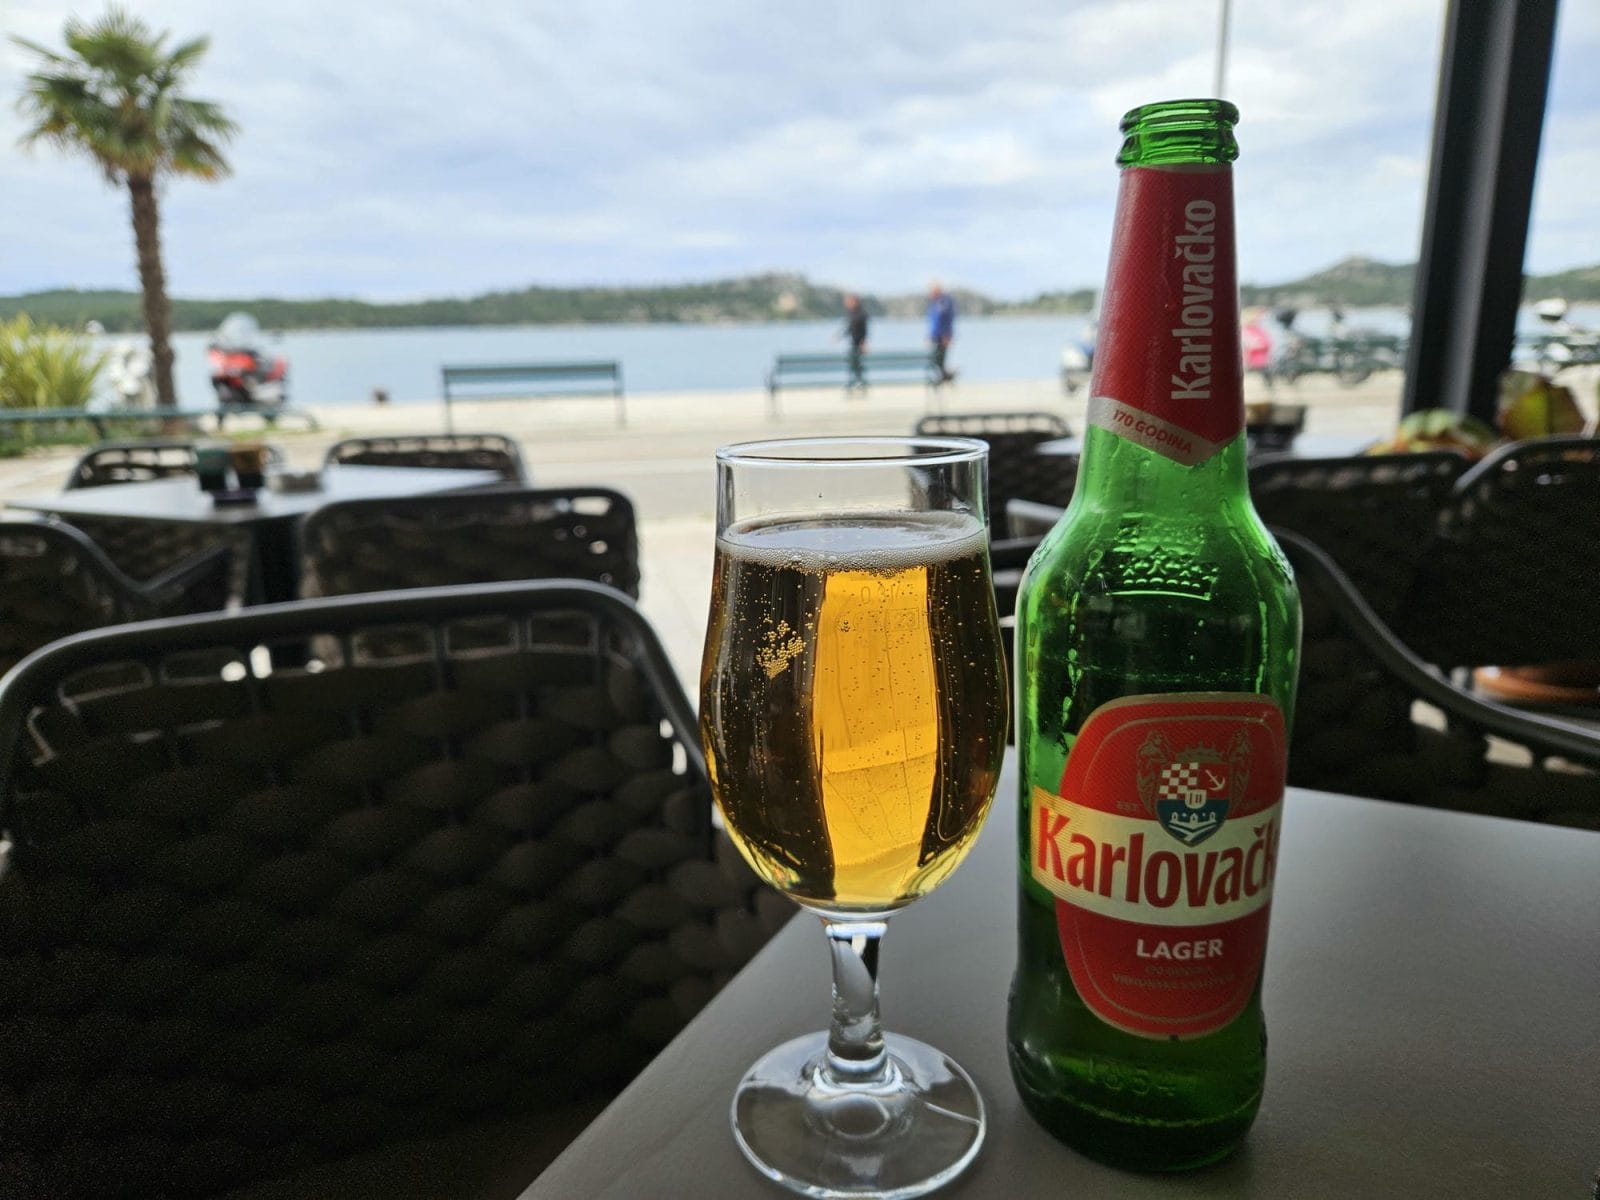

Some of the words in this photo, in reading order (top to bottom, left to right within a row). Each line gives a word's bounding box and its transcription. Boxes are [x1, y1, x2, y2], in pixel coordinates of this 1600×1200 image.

[1171, 200, 1216, 400] Karlovačko
[1113, 409, 1134, 427] 170
[1135, 420, 1192, 454] GODINA
[1037, 805, 1279, 908] Karlovačk
[1136, 938, 1224, 960] LAGER
